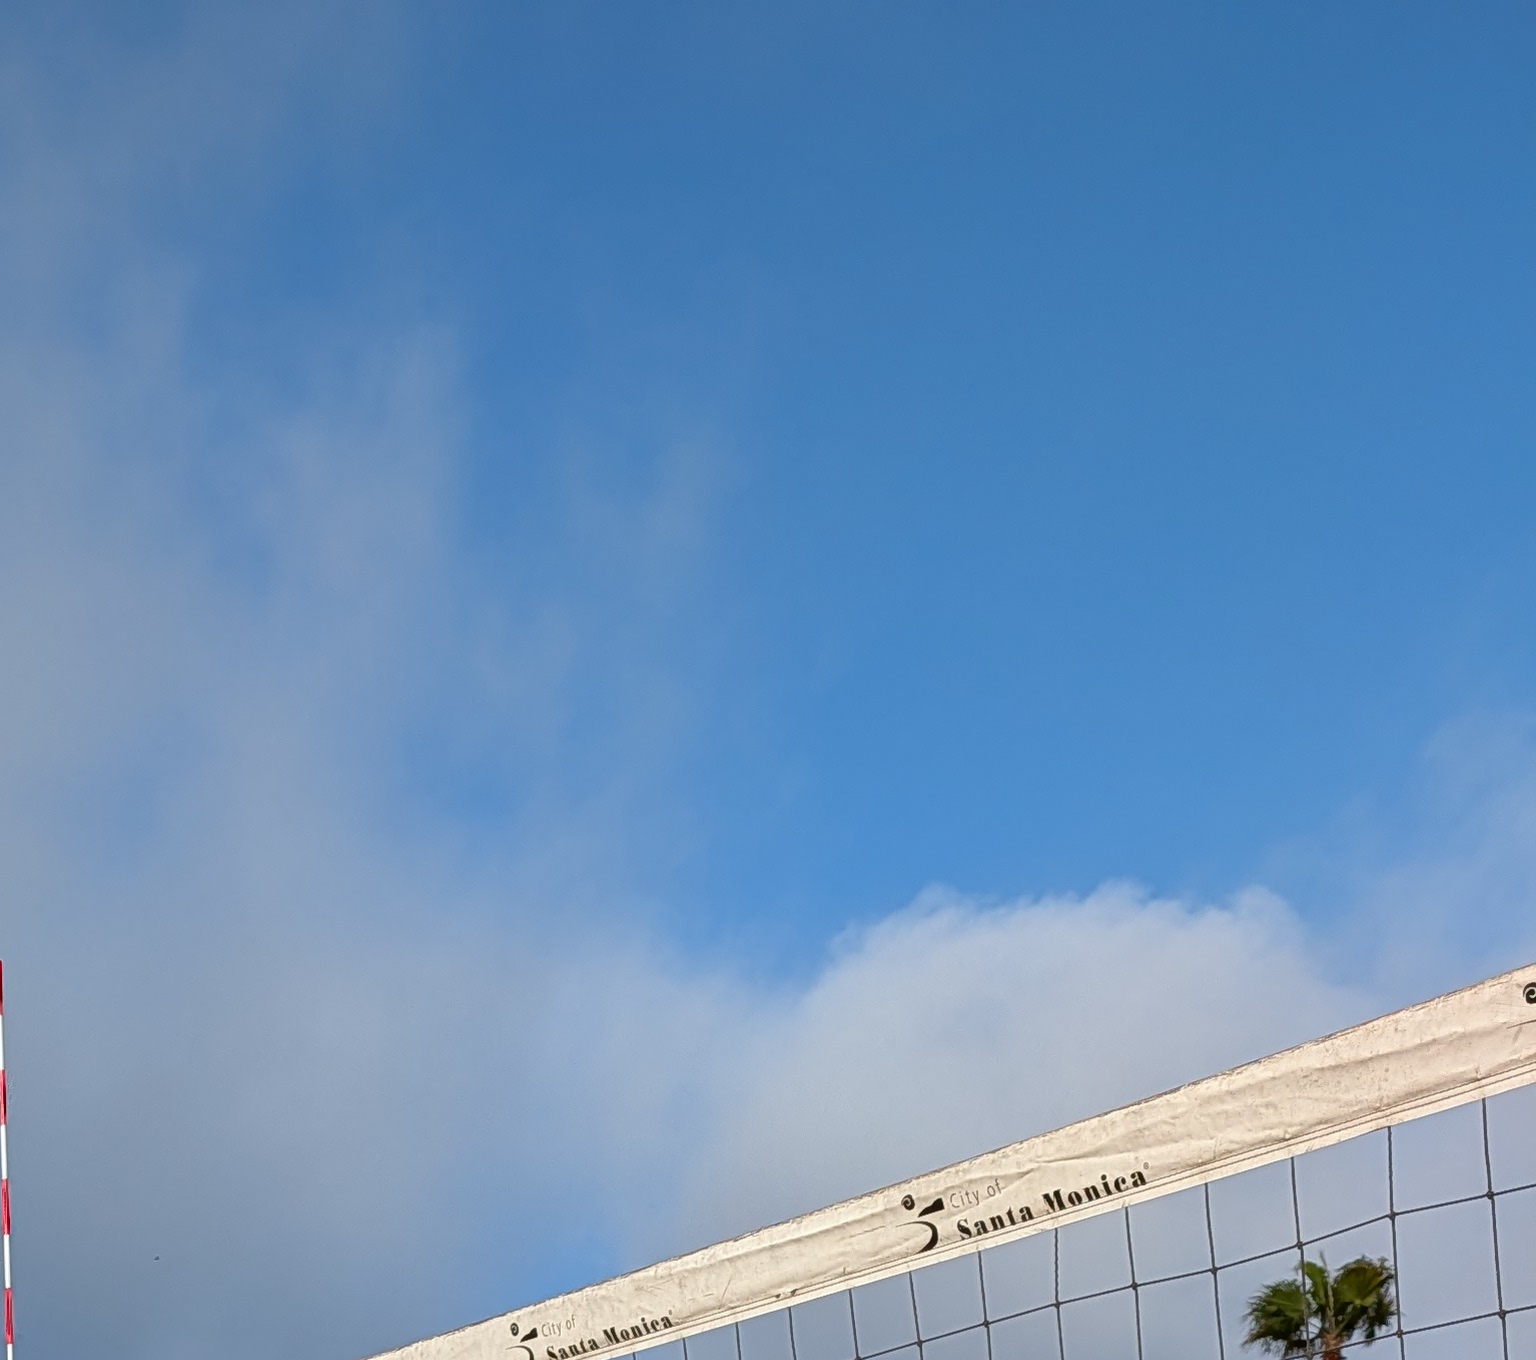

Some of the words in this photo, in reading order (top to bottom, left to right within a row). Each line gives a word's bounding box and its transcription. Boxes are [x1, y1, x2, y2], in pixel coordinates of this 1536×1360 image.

[949, 1190, 980, 1209] City
[987, 1178, 1003, 1198] of
[957, 1204, 1034, 1241] Santa
[541, 1320, 562, 1338] City
[566, 1315, 576, 1330] of
